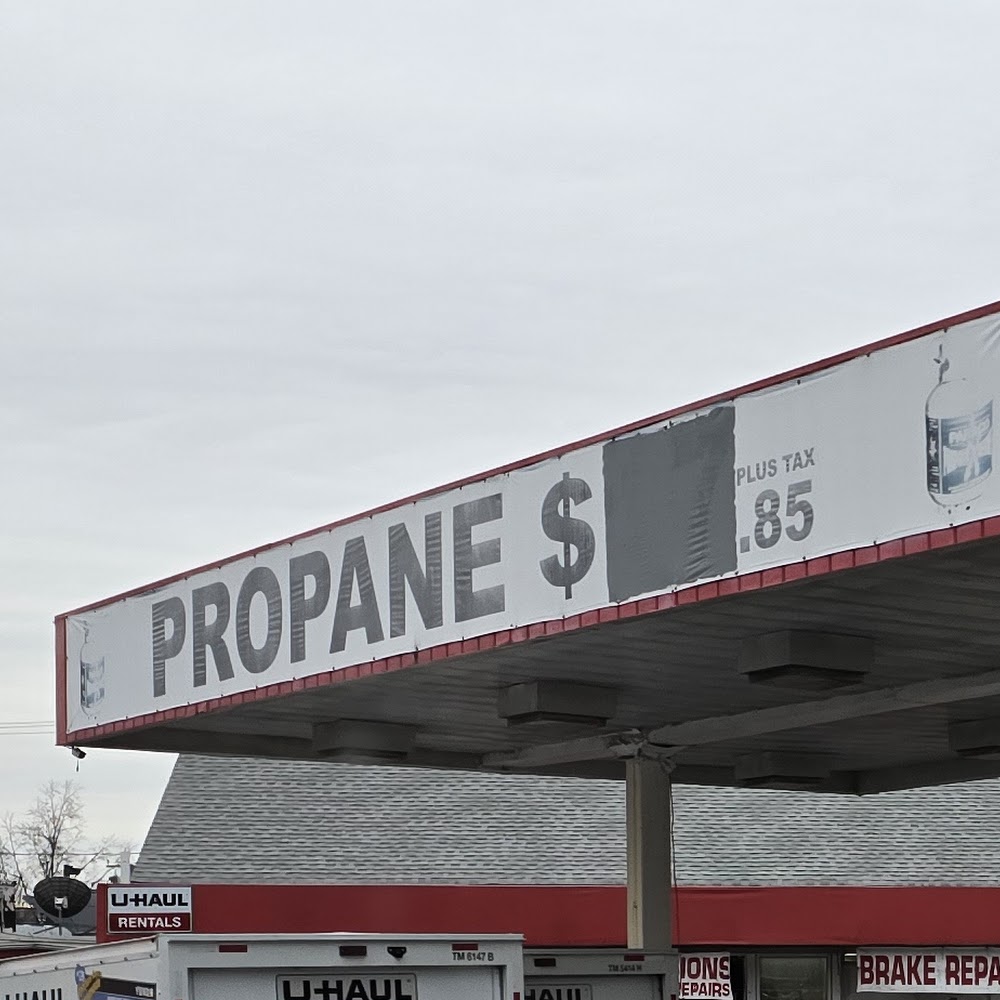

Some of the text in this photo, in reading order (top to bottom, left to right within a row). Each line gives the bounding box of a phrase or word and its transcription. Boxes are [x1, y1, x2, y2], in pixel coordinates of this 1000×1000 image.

[736, 447, 815, 487] PLUS TAX
[152, 493, 505, 697] PROPANE
[539, 472, 596, 600] $
[111, 893, 188, 907] U-HAUL
[118, 916, 182, 928] RENTALS
[861, 955, 936, 986] BRAKE
[679, 982, 730, 998] EPAIRS
